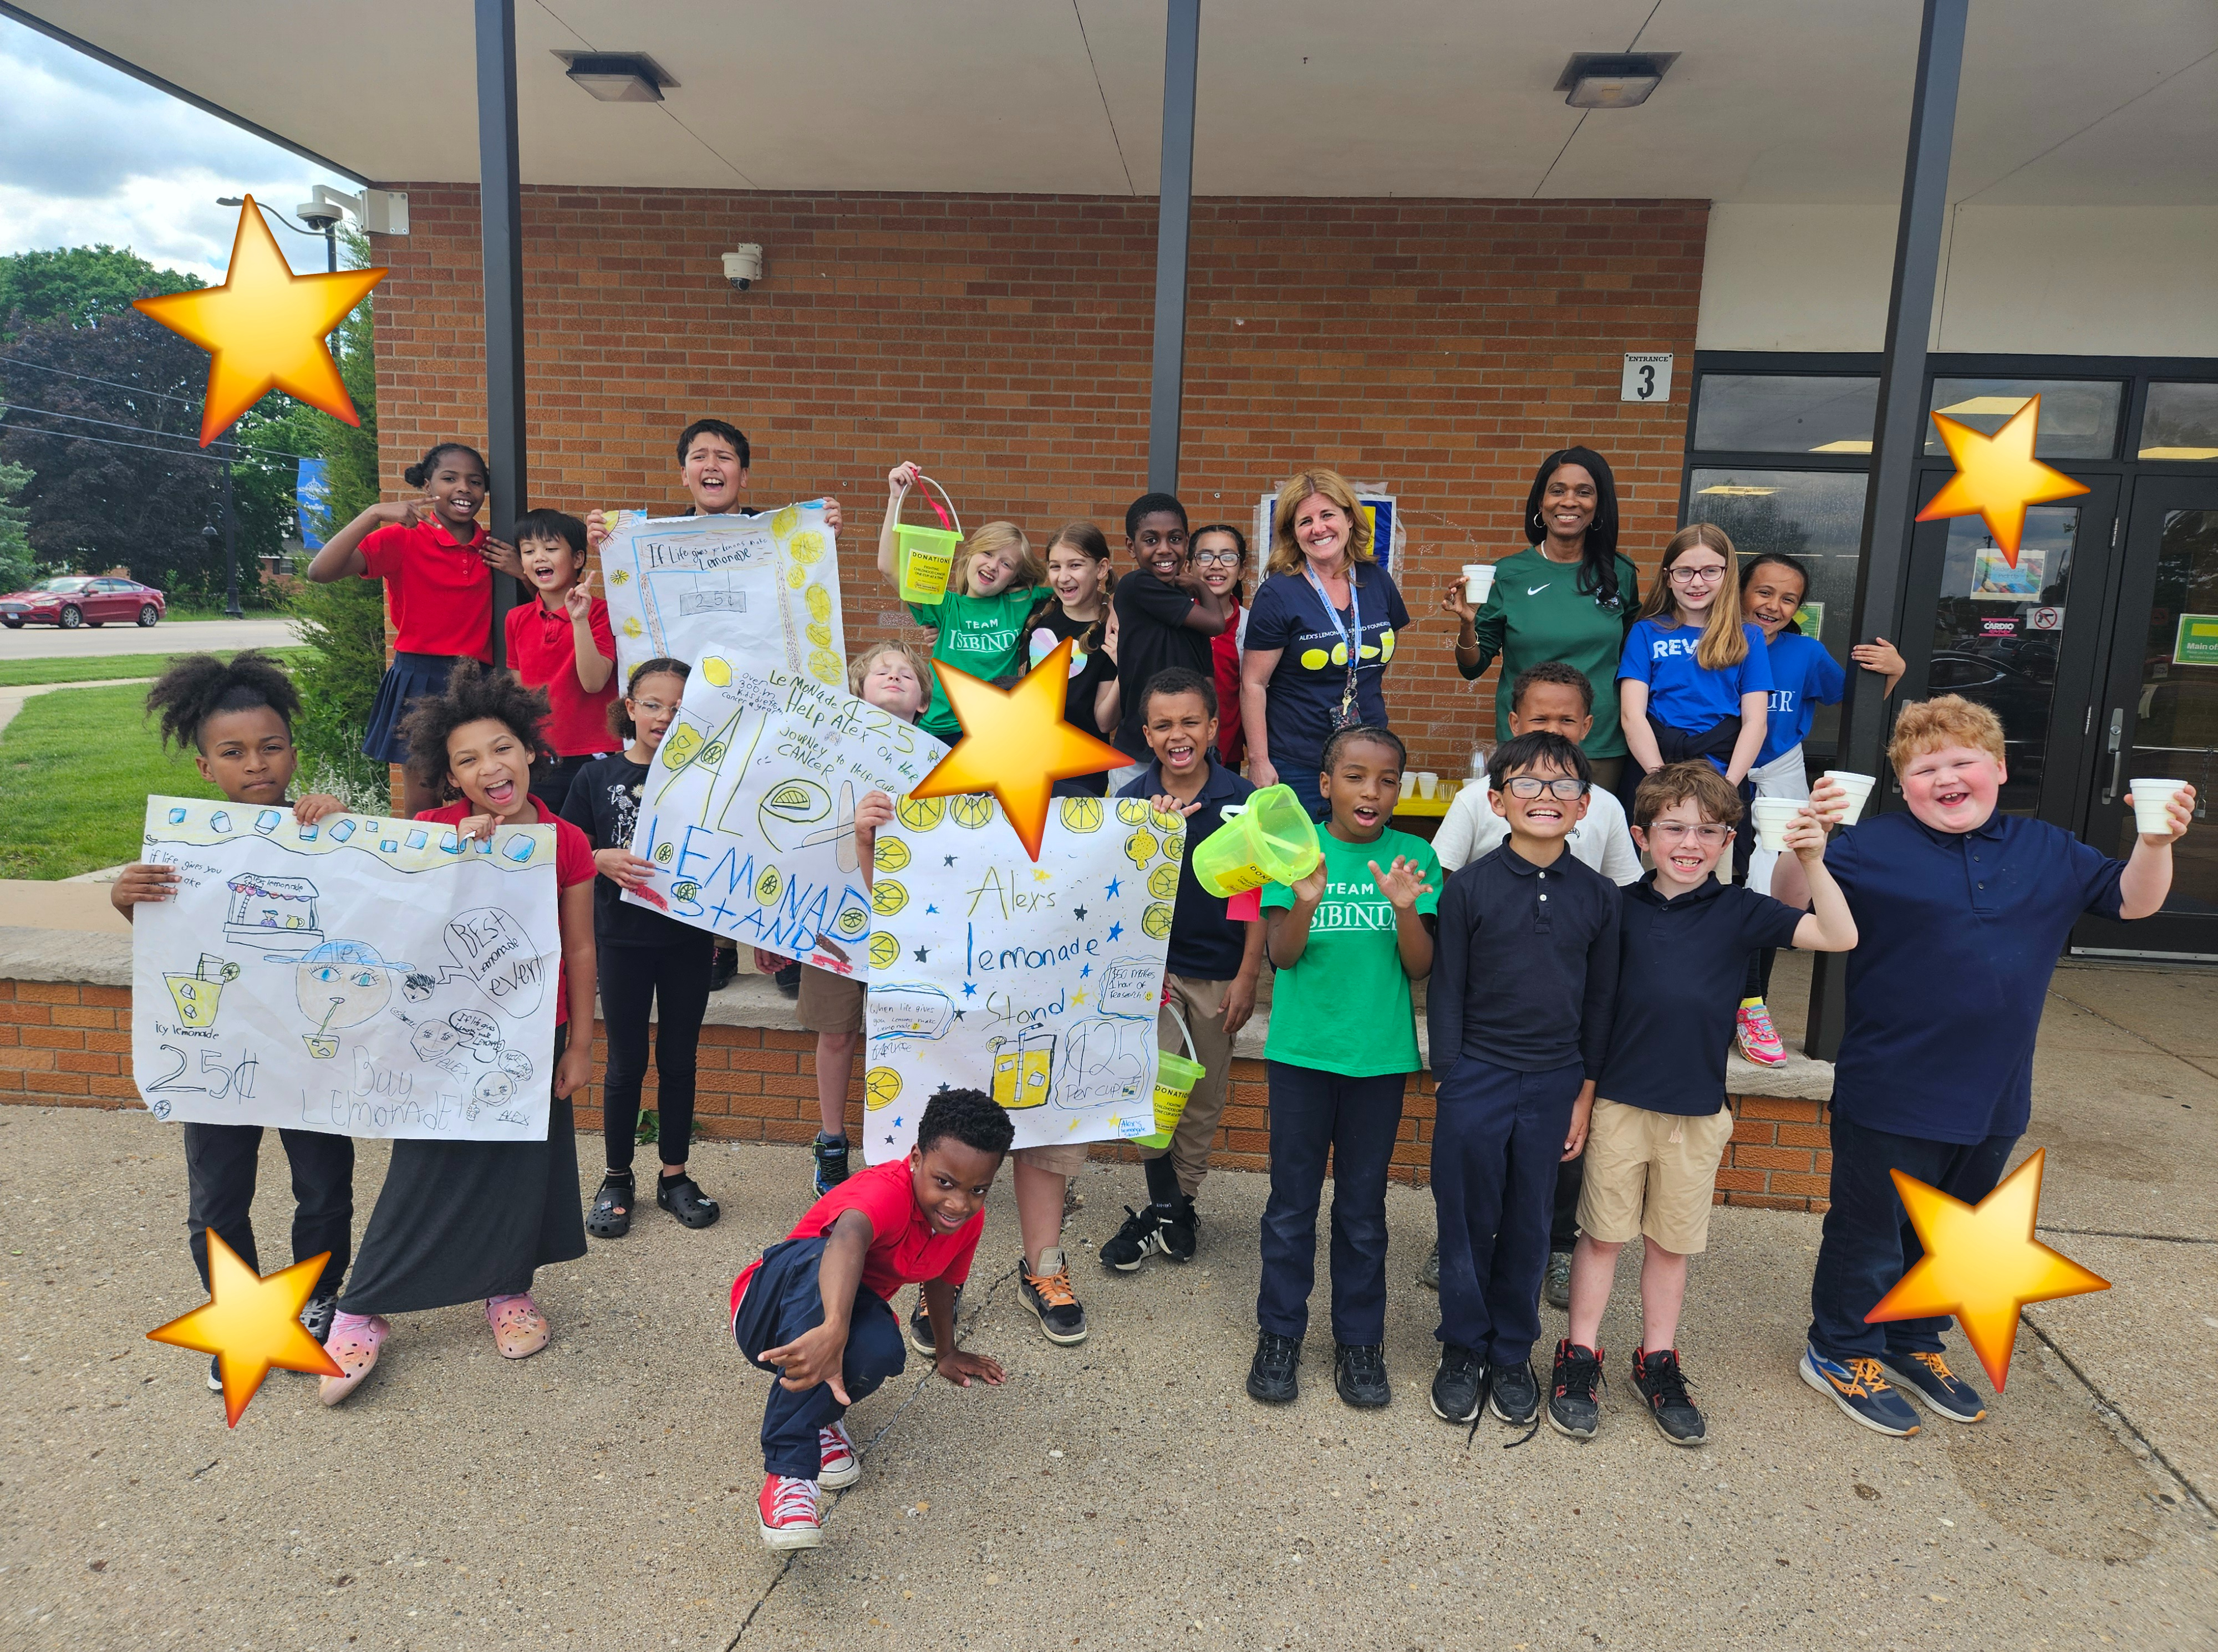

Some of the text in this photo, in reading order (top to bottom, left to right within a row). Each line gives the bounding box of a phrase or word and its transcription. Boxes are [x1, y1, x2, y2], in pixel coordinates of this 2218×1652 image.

[1637, 365, 1655, 398] 3
[647, 542, 665, 568] If
[669, 546, 688, 563] Life
[692, 547, 708, 562] gives
[913, 552, 950, 564] DONATIONS
[965, 619, 998, 629] TEAM
[1984, 622, 2014, 630] CARDIO
[1653, 638, 1700, 659] REV
[754, 703, 777, 715] year
[162, 851, 179, 865] life
[181, 860, 203, 872] gives
[204, 864, 223, 875] you
[1250, 865, 1275, 881] DONA
[184, 878, 201, 889] ake
[1326, 883, 1373, 895] TEAM
[311, 941, 367, 965] Alex
[155, 1021, 220, 1040] icy lemonade
